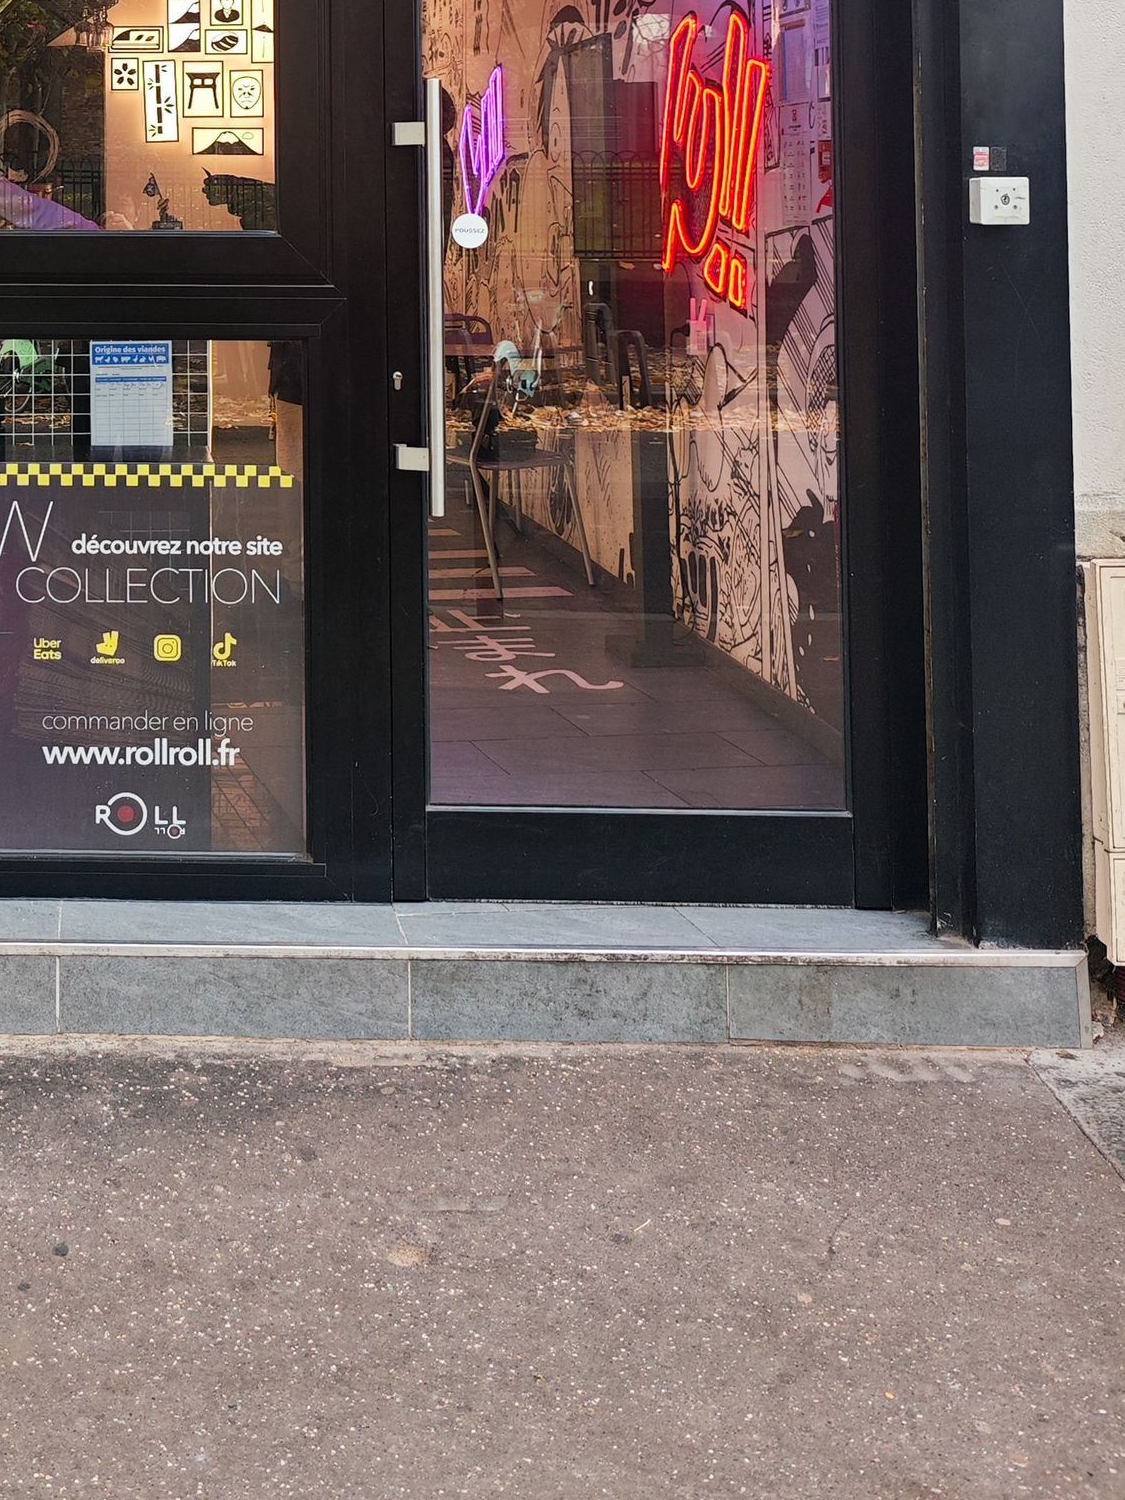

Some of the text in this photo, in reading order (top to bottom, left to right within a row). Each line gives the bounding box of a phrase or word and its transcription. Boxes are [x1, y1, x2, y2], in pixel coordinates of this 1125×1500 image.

[454, 227, 486, 235] POUSSEZ
[94, 345, 166, 355] Origine des viandes
[71, 533, 284, 556] découvrez notre site
[15, 566, 282, 605] COLLECTION
[33, 637, 62, 649] Uber
[33, 649, 62, 661] Eats
[90, 656, 126, 665] deliveroo
[211, 659, 238, 667] TikTok
[42, 710, 254, 737] commander en ligne
[42, 738, 241, 766] www.rollroll.fr
[95, 792, 187, 836] ROLL
